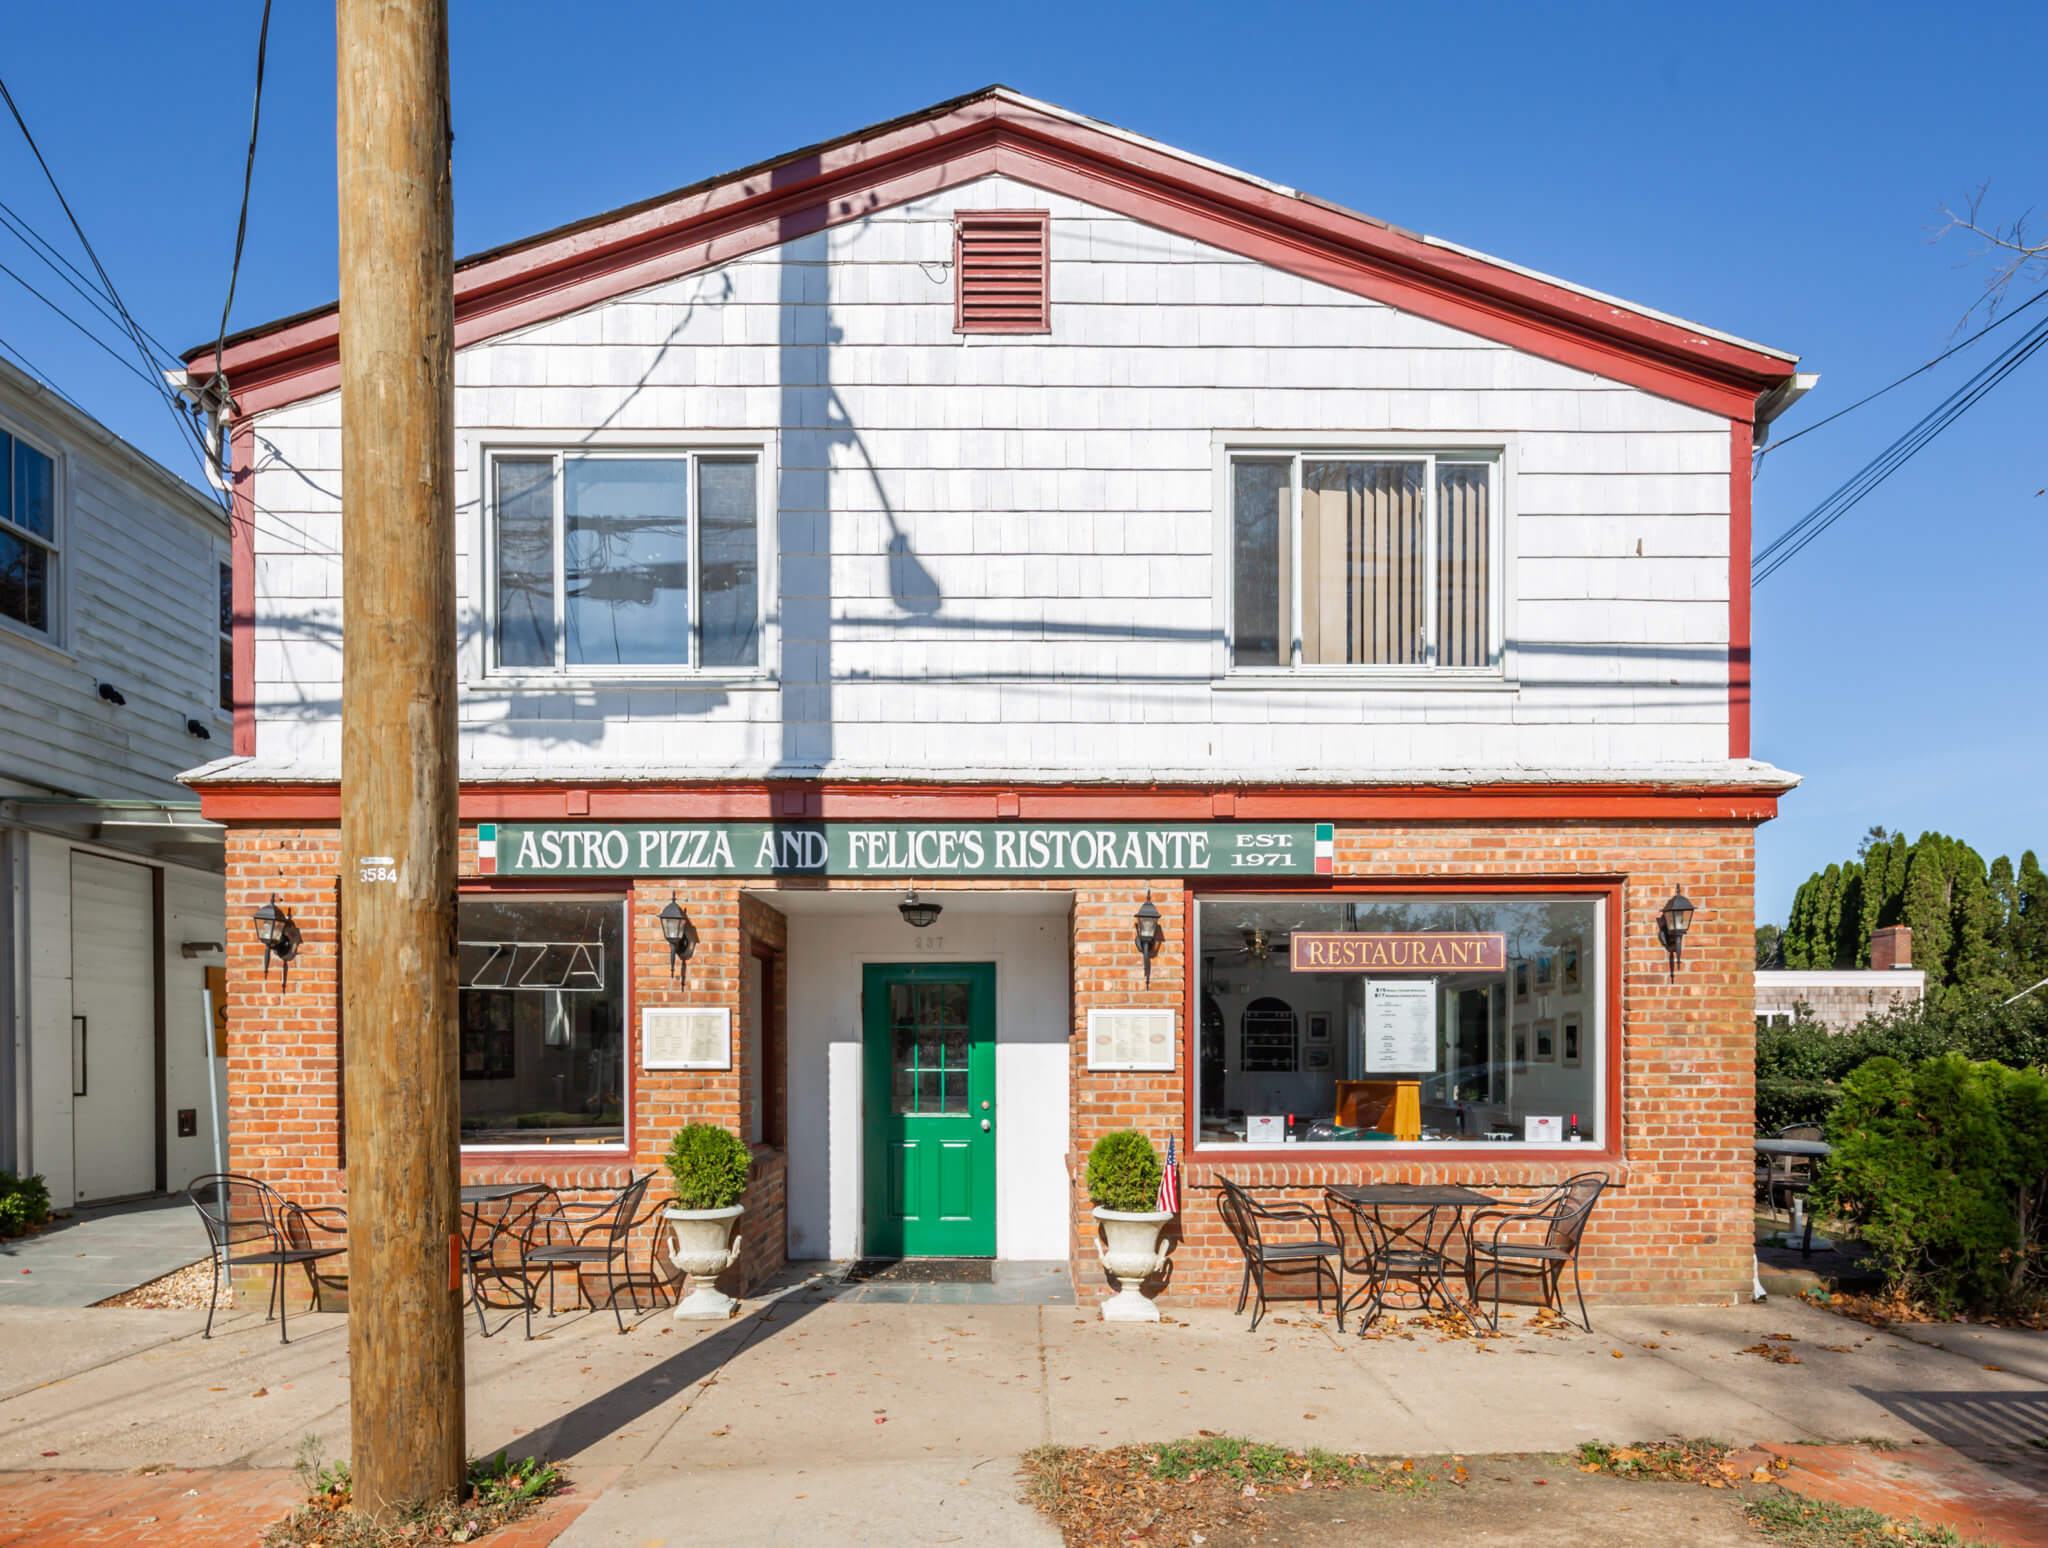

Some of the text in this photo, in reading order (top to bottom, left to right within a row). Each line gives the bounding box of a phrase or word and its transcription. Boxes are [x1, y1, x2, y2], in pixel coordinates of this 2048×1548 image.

[515, 830, 1211, 869] ASTRO PIZZA AND FELICE'S RISTORANTE
[1231, 853, 1297, 867] 1971
[360, 867, 397, 883] 3584
[1308, 941, 1488, 965] RESTAURANT
